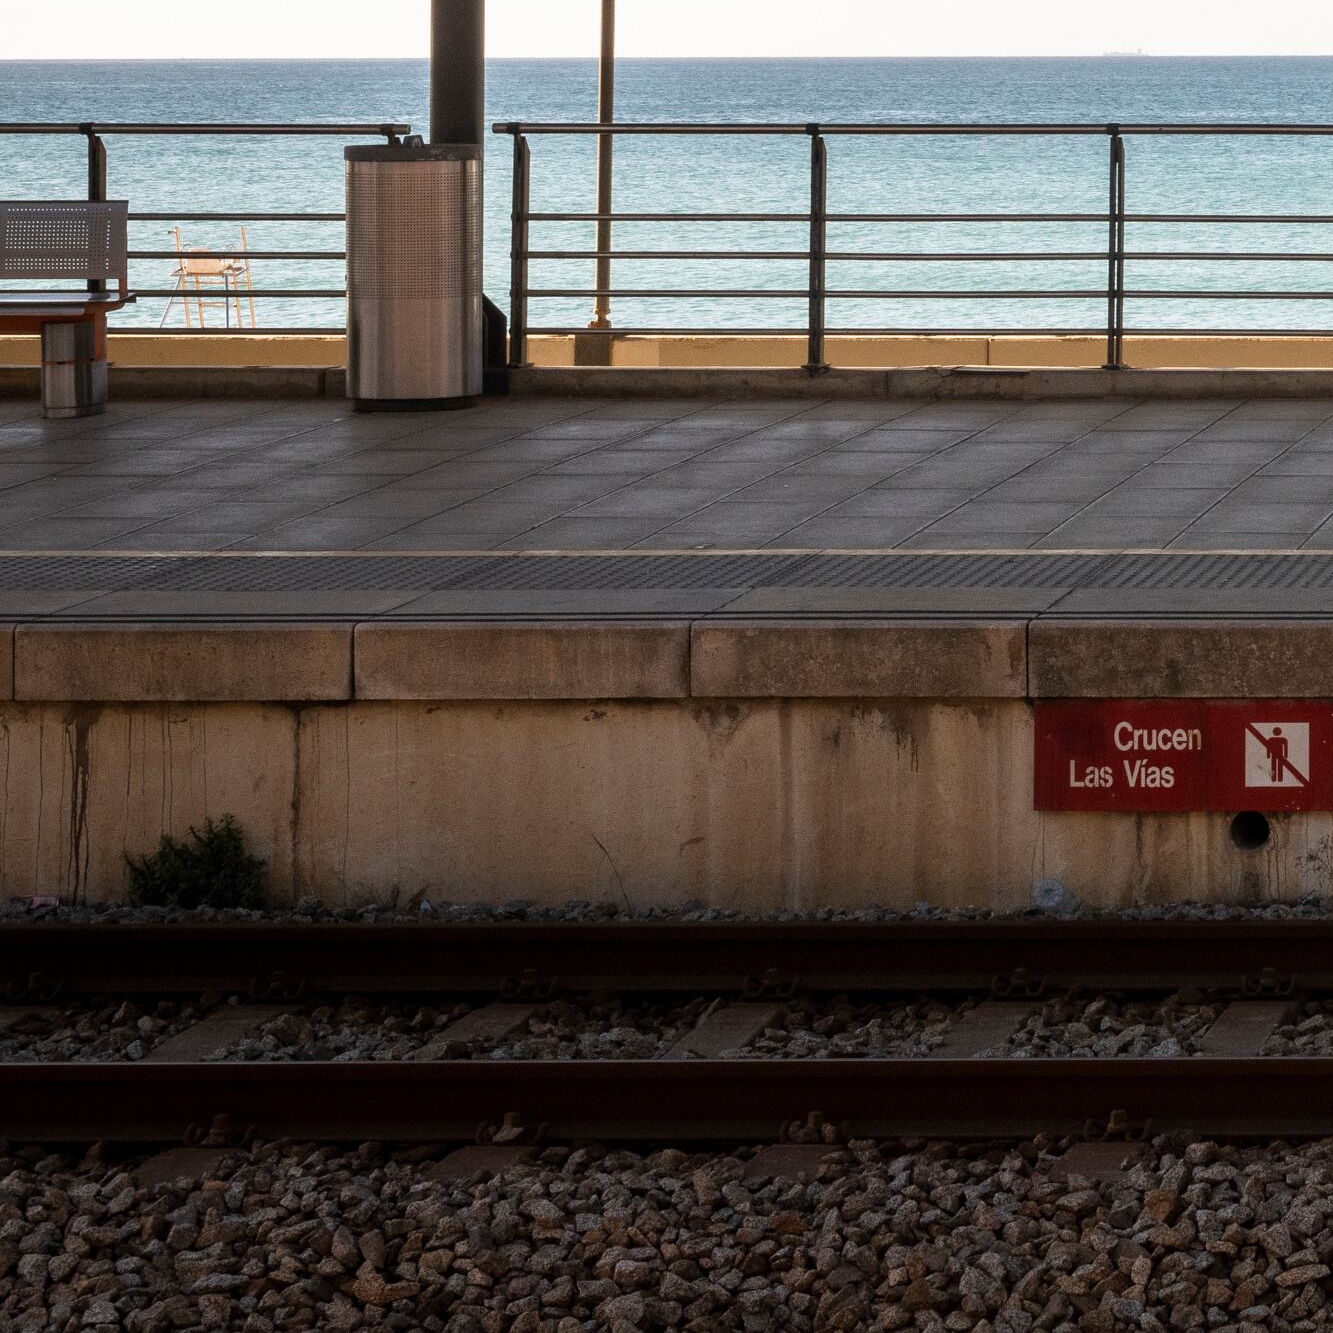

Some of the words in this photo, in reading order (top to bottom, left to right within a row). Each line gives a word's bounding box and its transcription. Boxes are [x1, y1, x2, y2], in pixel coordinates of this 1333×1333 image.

[1113, 721, 1202, 752] Crucen
[1069, 759, 1114, 788] Las
[1123, 758, 1175, 788] Vías
